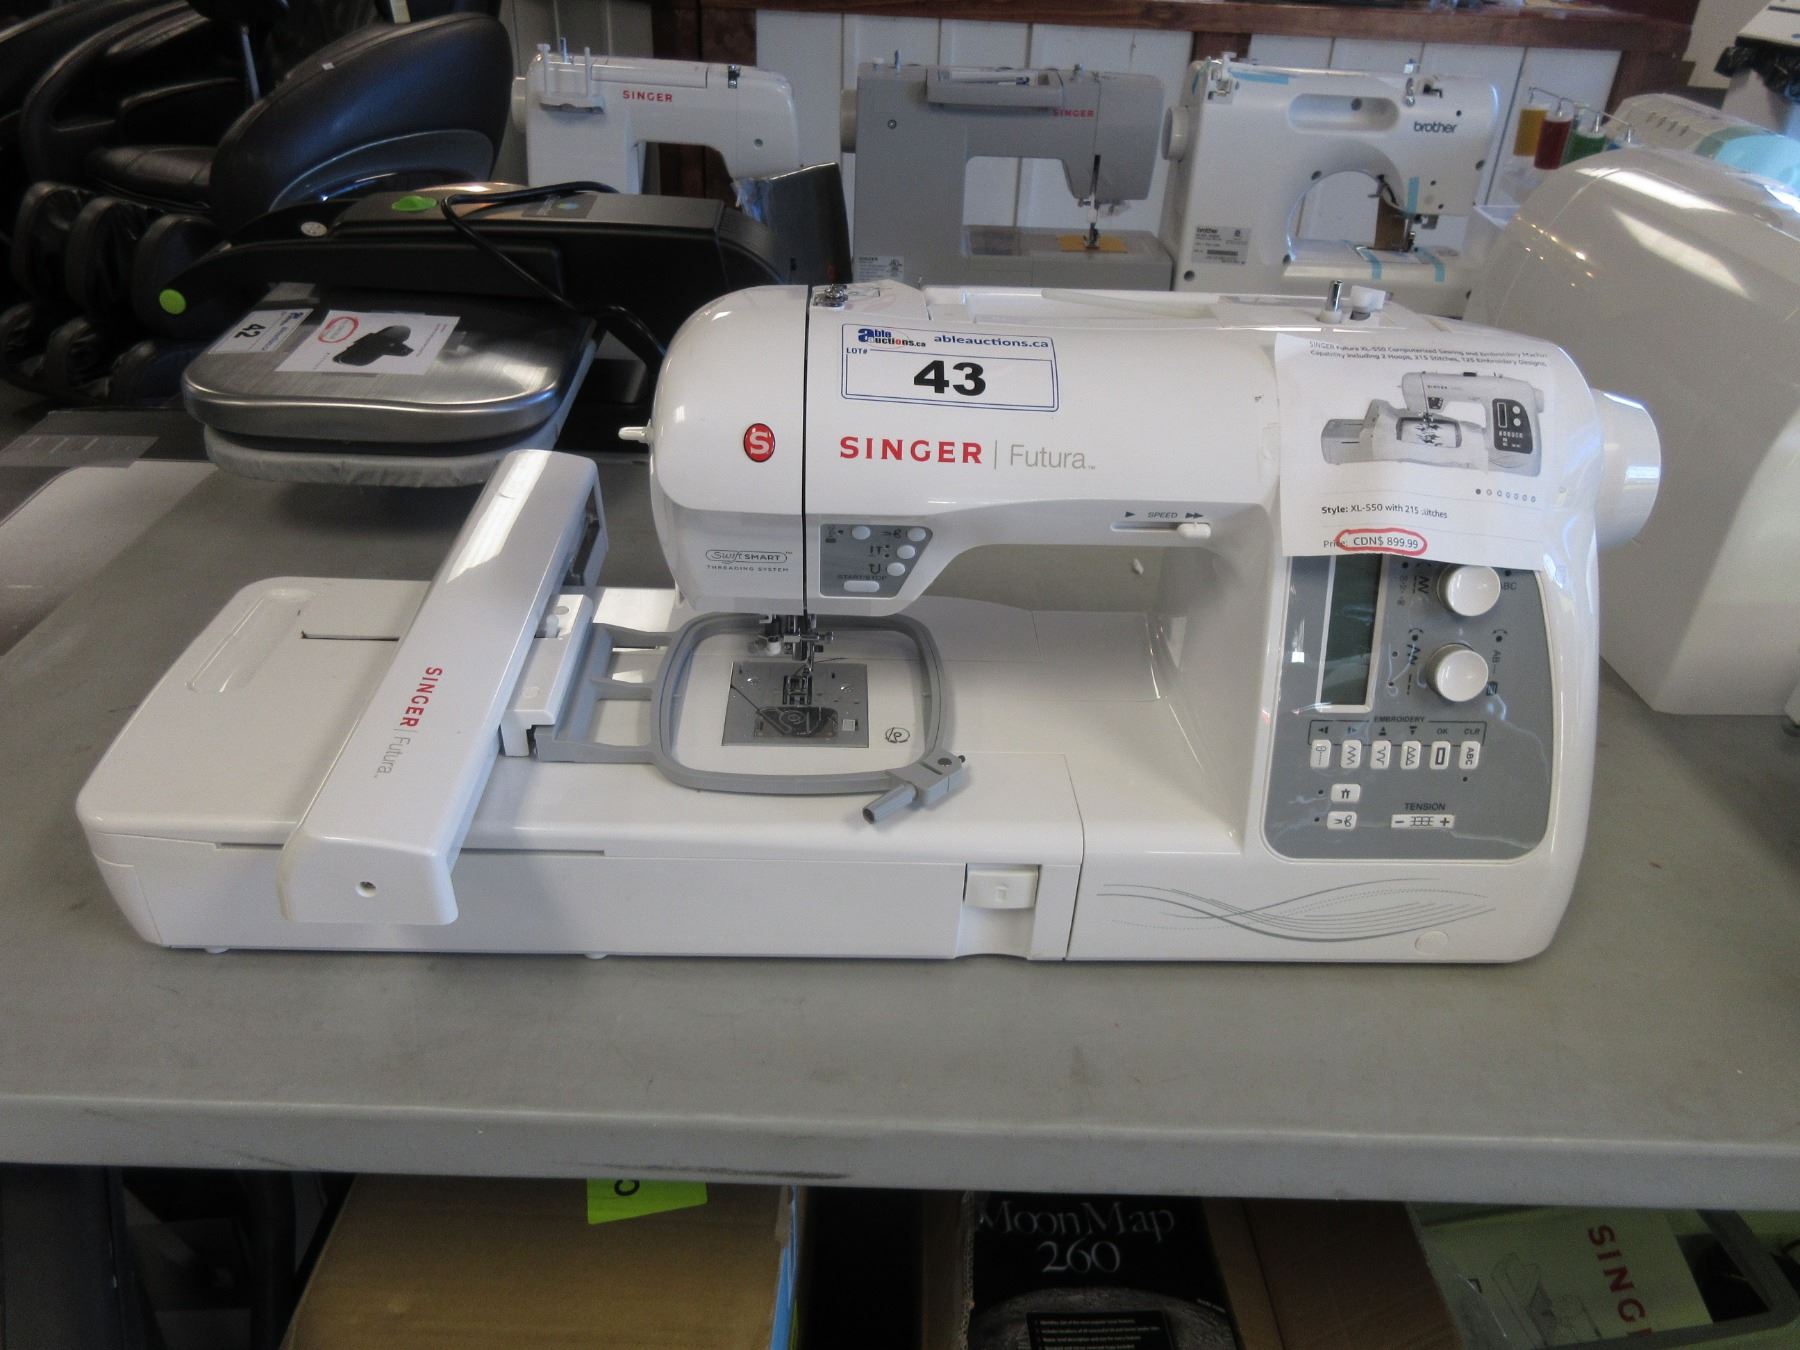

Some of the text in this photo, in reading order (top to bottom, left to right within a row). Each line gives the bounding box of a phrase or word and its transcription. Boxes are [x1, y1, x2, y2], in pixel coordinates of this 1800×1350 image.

[622, 90, 673, 103] SINGER
[1053, 108, 1095, 118] SINGER
[1413, 120, 1458, 134] brother
[234, 324, 266, 339] 42
[933, 334, 1049, 349] ableauctions.ca
[913, 359, 986, 397] 43
[747, 431, 771, 455] S
[839, 436, 983, 465] SINGER
[1147, 511, 1178, 519] SPEED
[1321, 505, 1349, 515] Style:
[1350, 503, 1383, 513] XL-550
[1385, 503, 1404, 514] with
[1405, 505, 1419, 515] 215
[1353, 535, 1384, 547] CDN$
[1387, 536, 1419, 549] 899.99
[744, 553, 781, 562] SMART
[1500, 580, 1517, 591] BC
[400, 666, 443, 728] SINGER
[1436, 727, 1481, 736] OK CLR
[1464, 747, 1474, 766] ABC
[1404, 802, 1446, 811] TENSION
[1036, 1238, 1121, 1274] 260
[1587, 1223, 1653, 1338] SING
